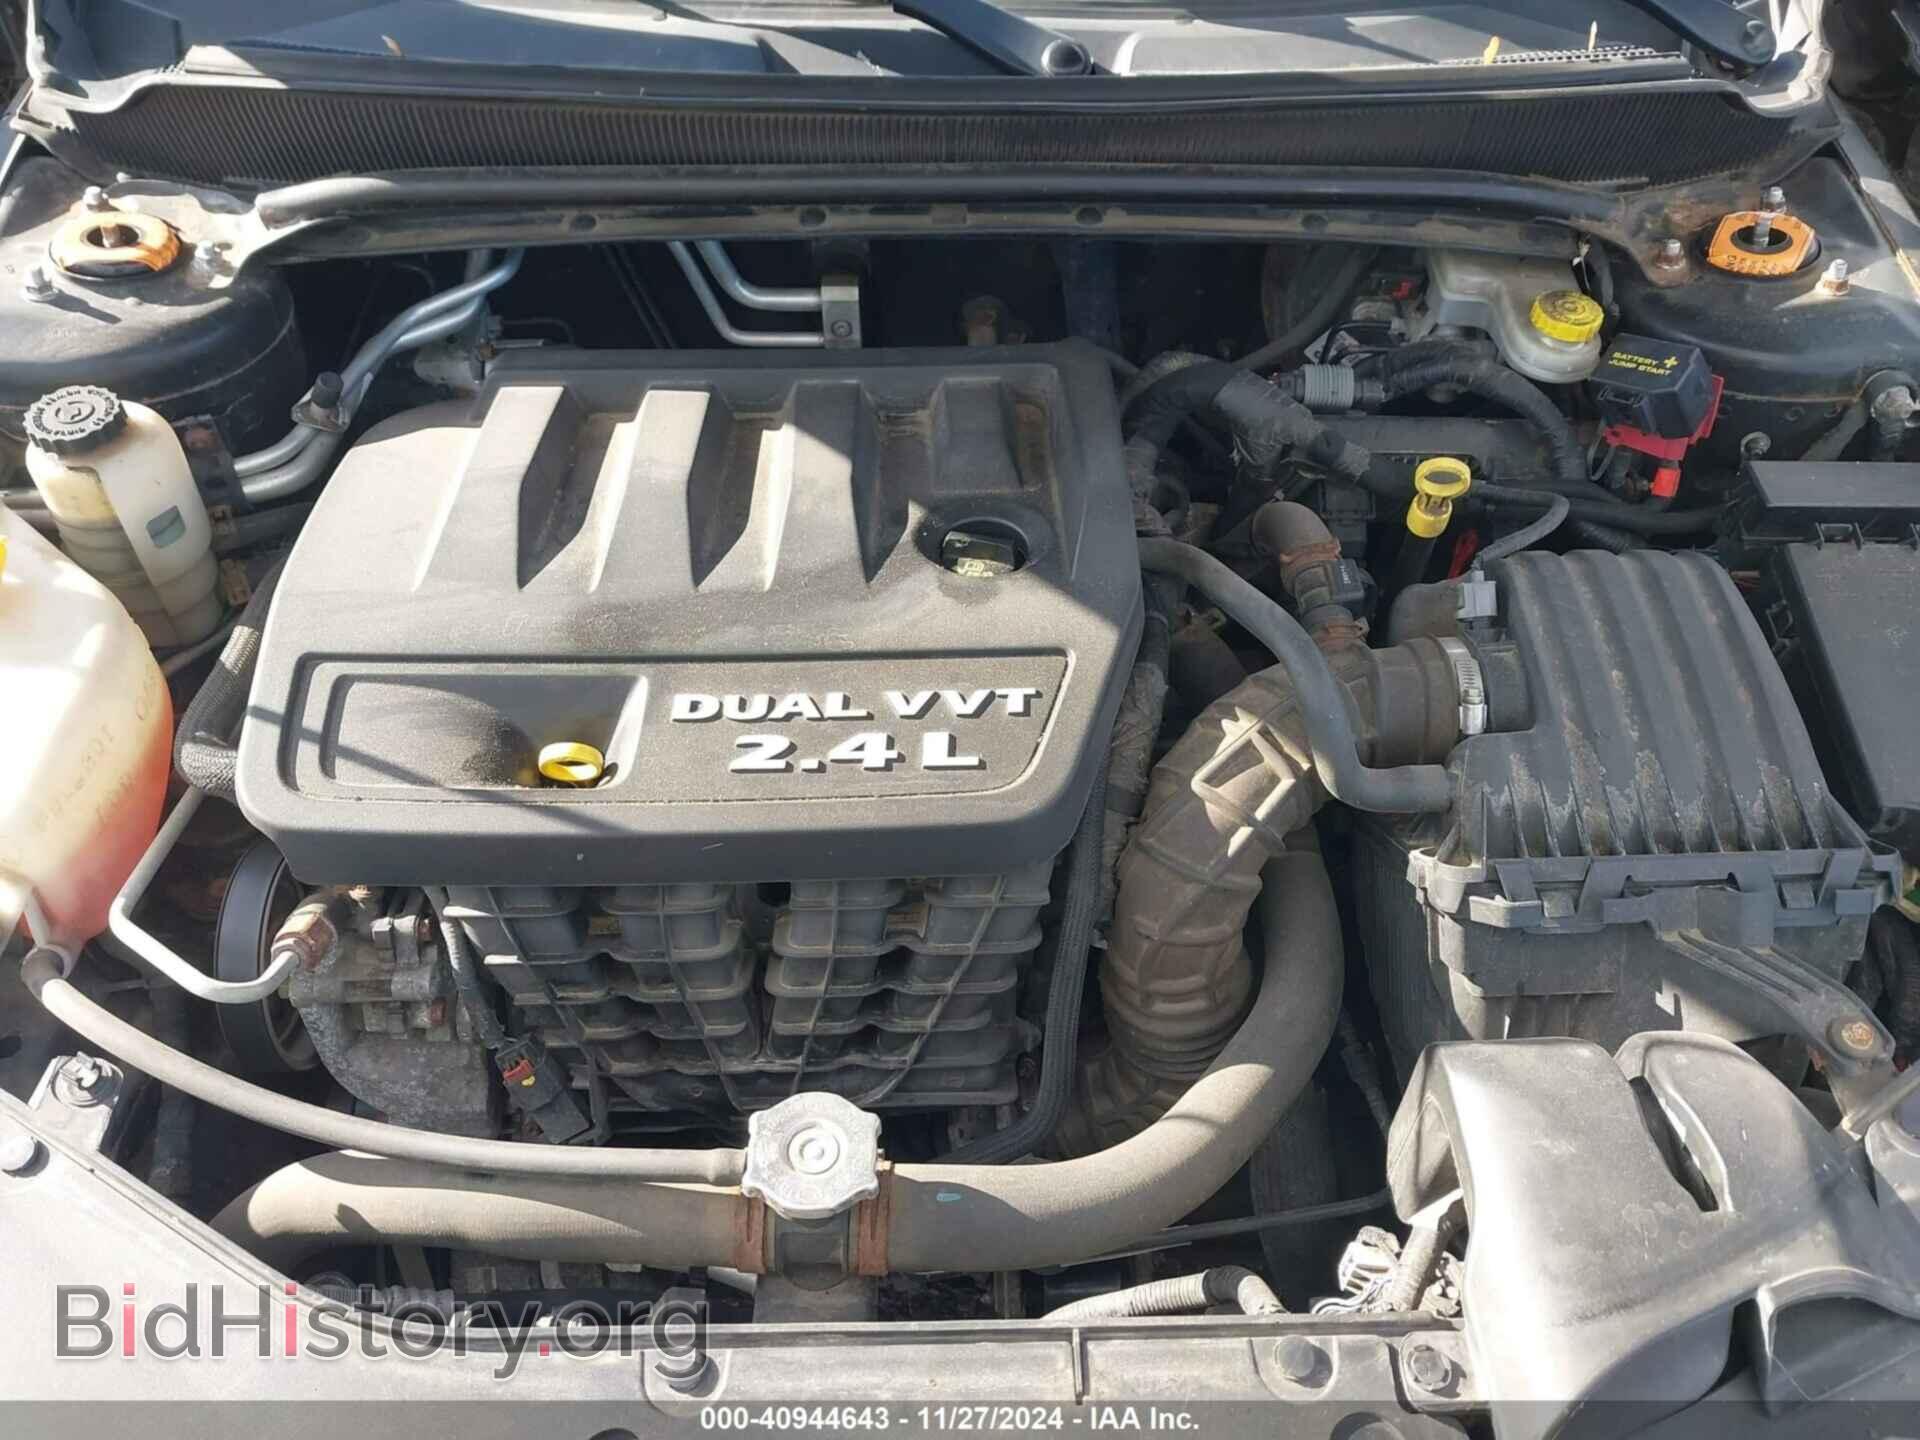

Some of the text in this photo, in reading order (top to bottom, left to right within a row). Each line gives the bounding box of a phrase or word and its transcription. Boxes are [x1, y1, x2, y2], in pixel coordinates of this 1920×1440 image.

[1608, 358, 1673, 376] JUMP START
[1612, 352, 1659, 366] BATTERY
[672, 687, 1042, 722] DUAL VVT
